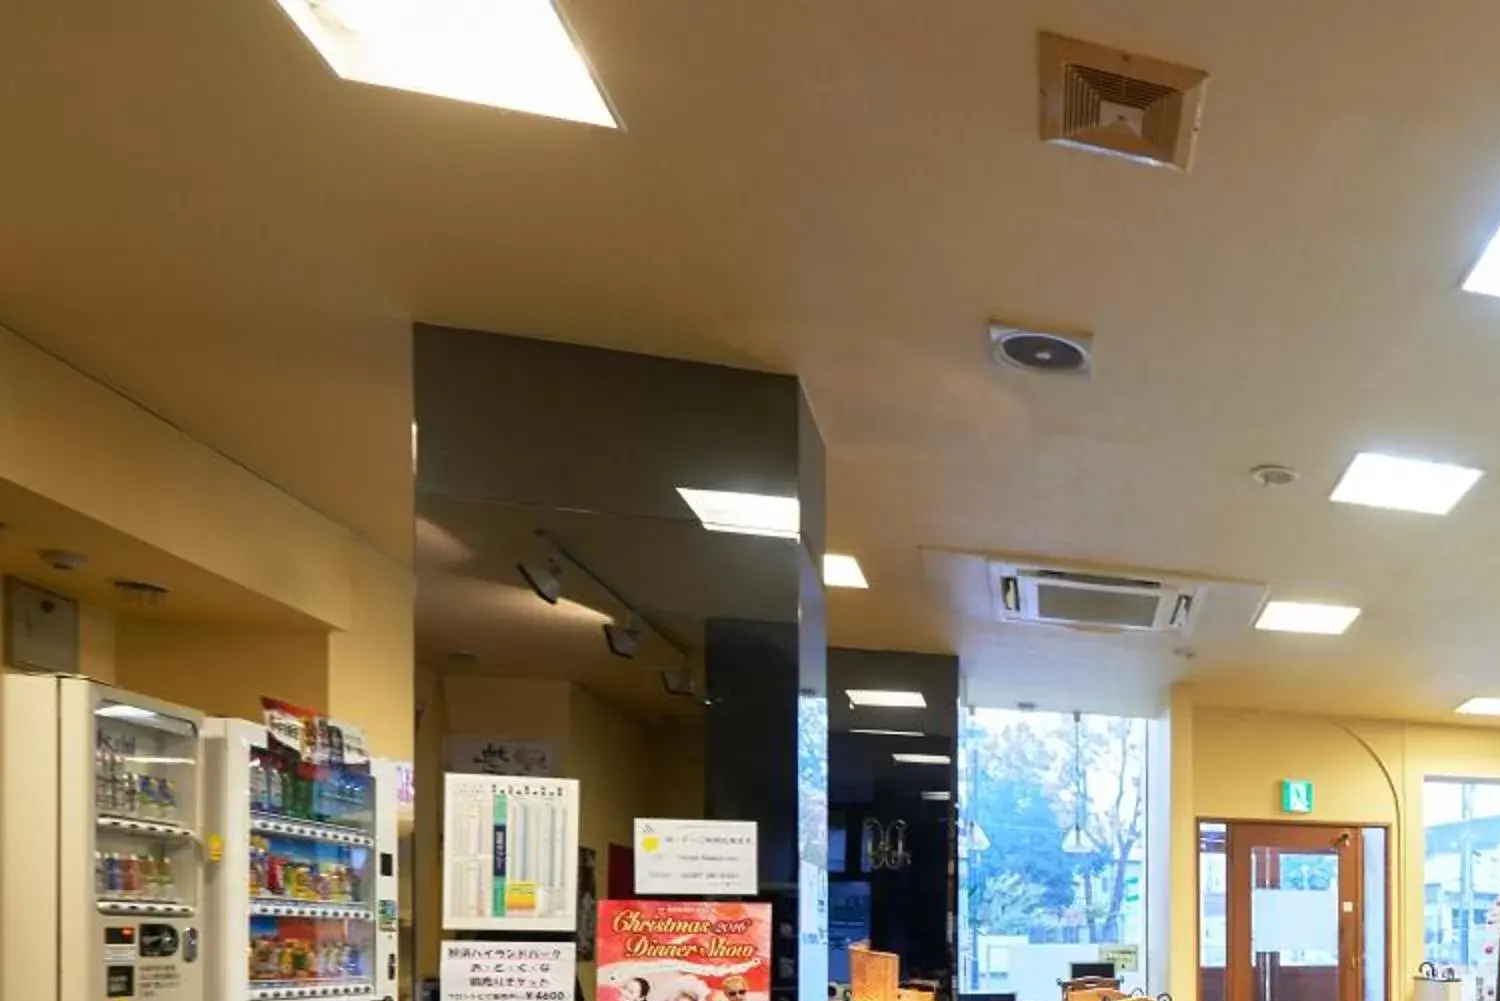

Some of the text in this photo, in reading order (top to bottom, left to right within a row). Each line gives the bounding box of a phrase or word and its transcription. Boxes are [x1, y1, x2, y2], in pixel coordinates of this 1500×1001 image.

[613, 908, 711, 933] Christmas
[625, 935, 755, 958] Dinner Show
